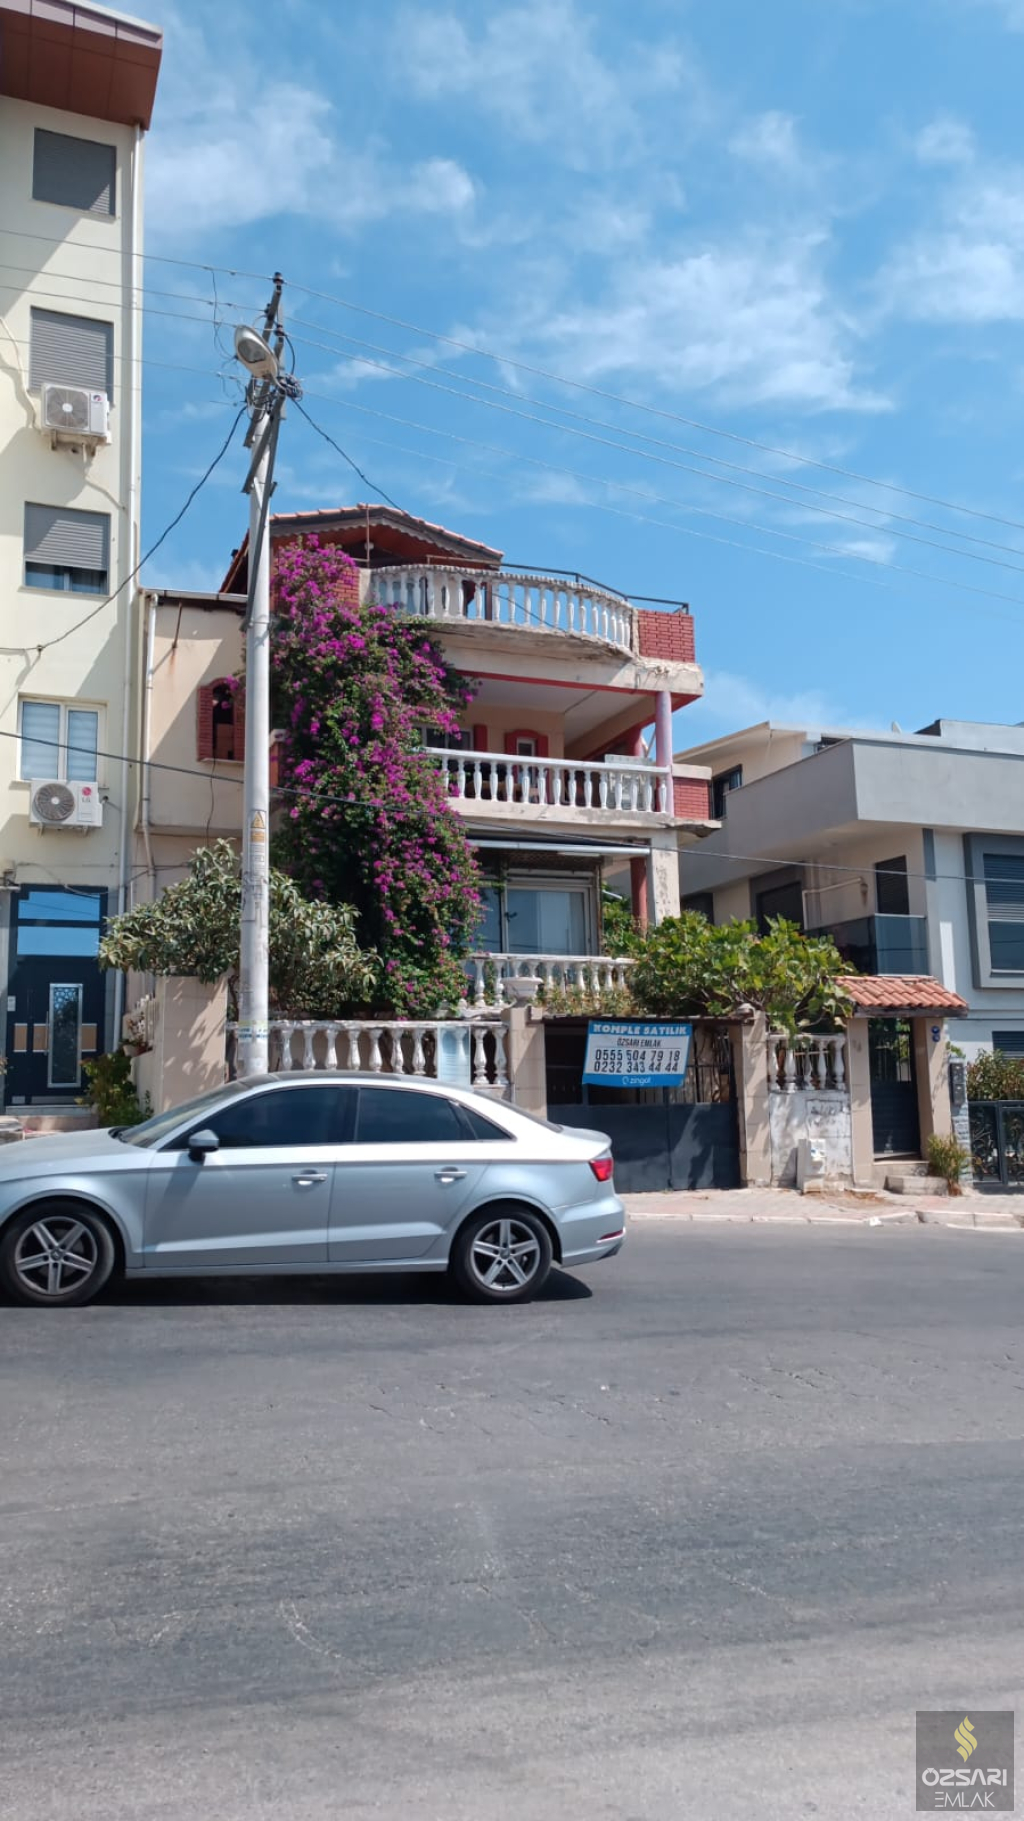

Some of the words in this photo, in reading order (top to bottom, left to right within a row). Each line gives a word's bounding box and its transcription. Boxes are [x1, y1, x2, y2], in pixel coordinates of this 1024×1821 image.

[594, 1024, 640, 1034] KOMPLE
[644, 1026, 686, 1035] SATILIK
[595, 1049, 623, 1061] 0555
[626, 1050, 646, 1061] 504
[651, 1050, 664, 1061] 79
[669, 1050, 680, 1061] 18
[594, 1061, 623, 1073] 0232
[627, 1062, 645, 1073] 343
[649, 1062, 662, 1072] 44
[665, 1062, 678, 1072] 44
